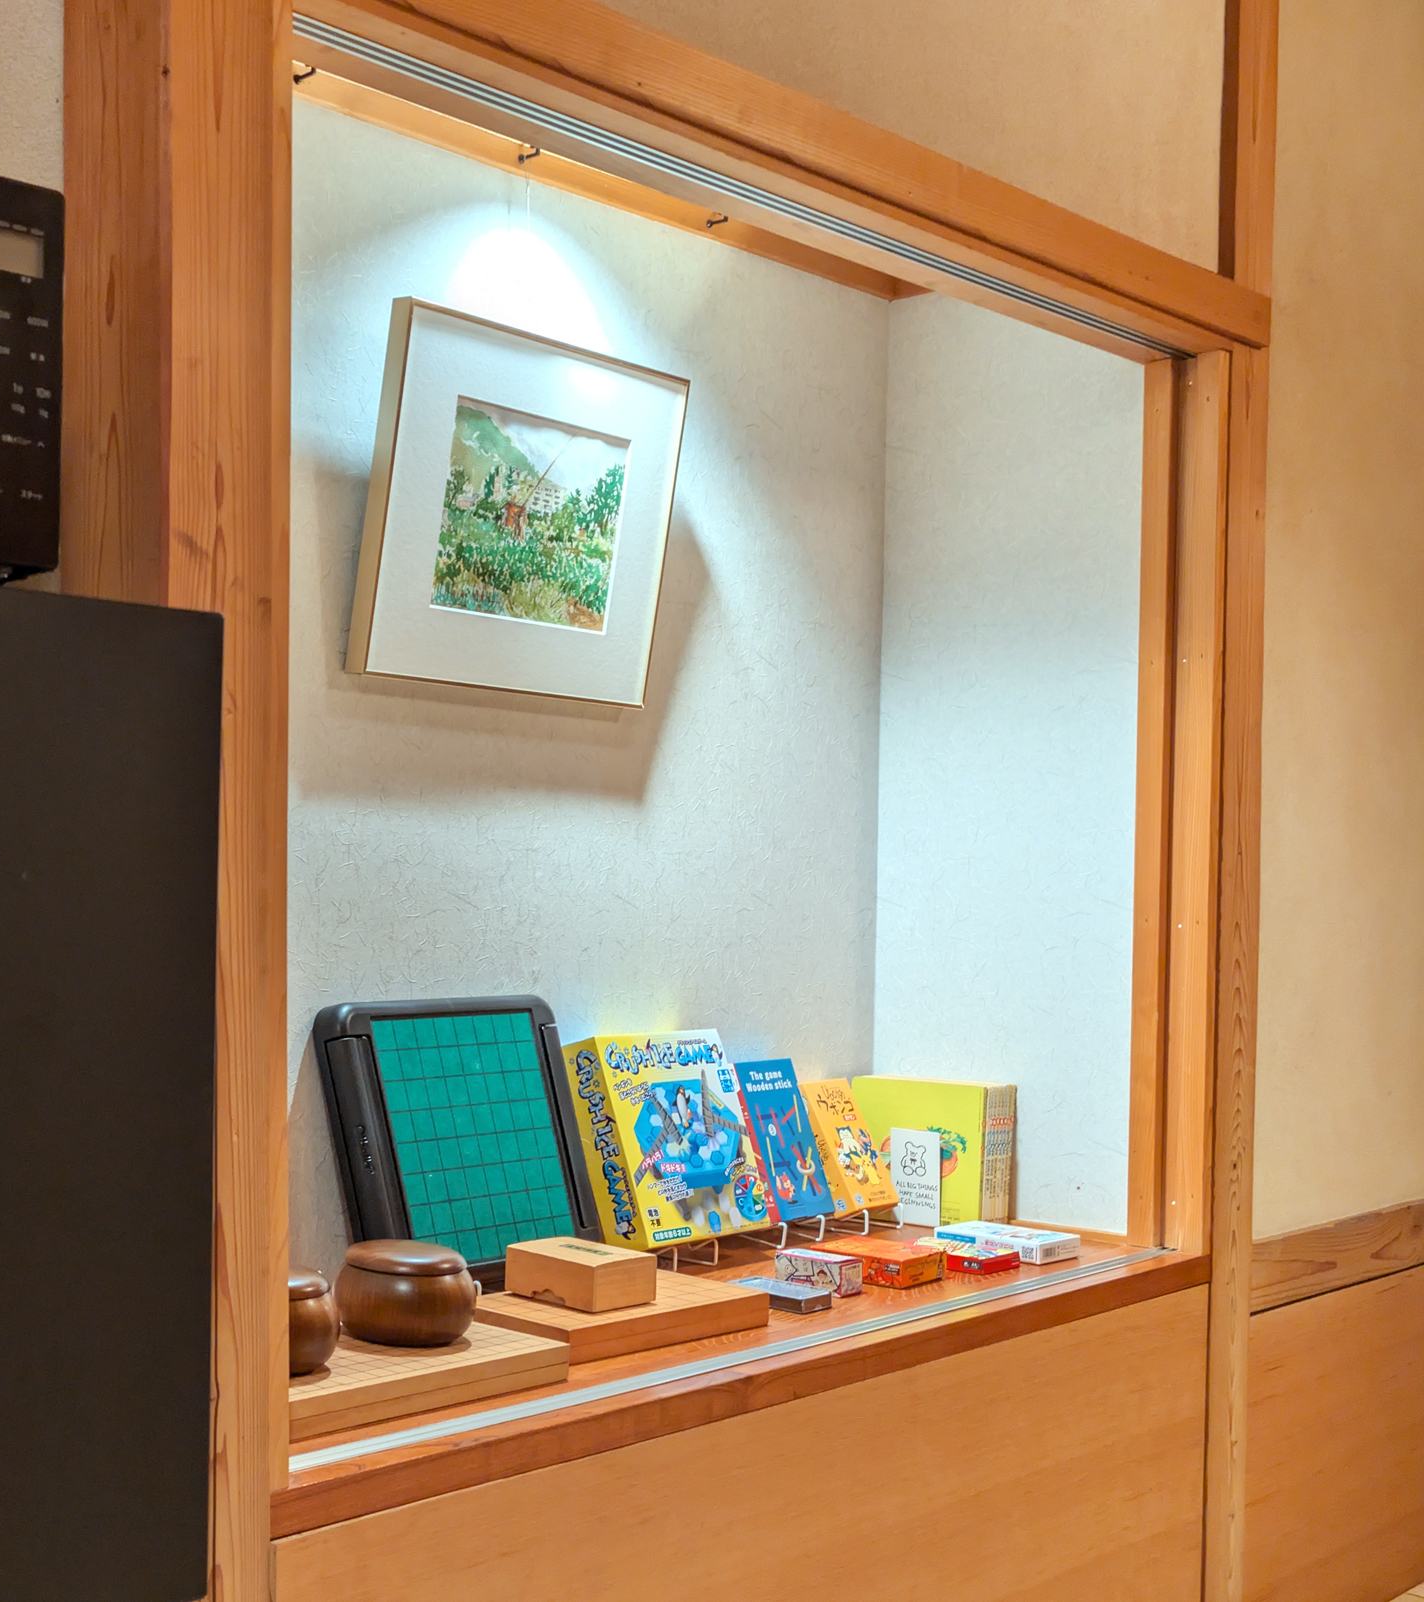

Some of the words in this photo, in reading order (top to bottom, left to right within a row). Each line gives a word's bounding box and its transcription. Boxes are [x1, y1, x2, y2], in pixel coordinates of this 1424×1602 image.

[604, 1041, 656, 1075] CRUSH
[675, 1043, 717, 1067] GAME
[749, 1071, 764, 1081] The
[764, 1070, 783, 1081] game
[745, 1081, 774, 1093] Wooden
[774, 1078, 793, 1090] stick
[576, 1050, 606, 1125] CRUSH
[602, 1159, 634, 1225] GAME
[917, 1183, 938, 1192] THINGS
[915, 1191, 934, 1201] SMALL
[898, 1197, 936, 1210] EGINNINGS
